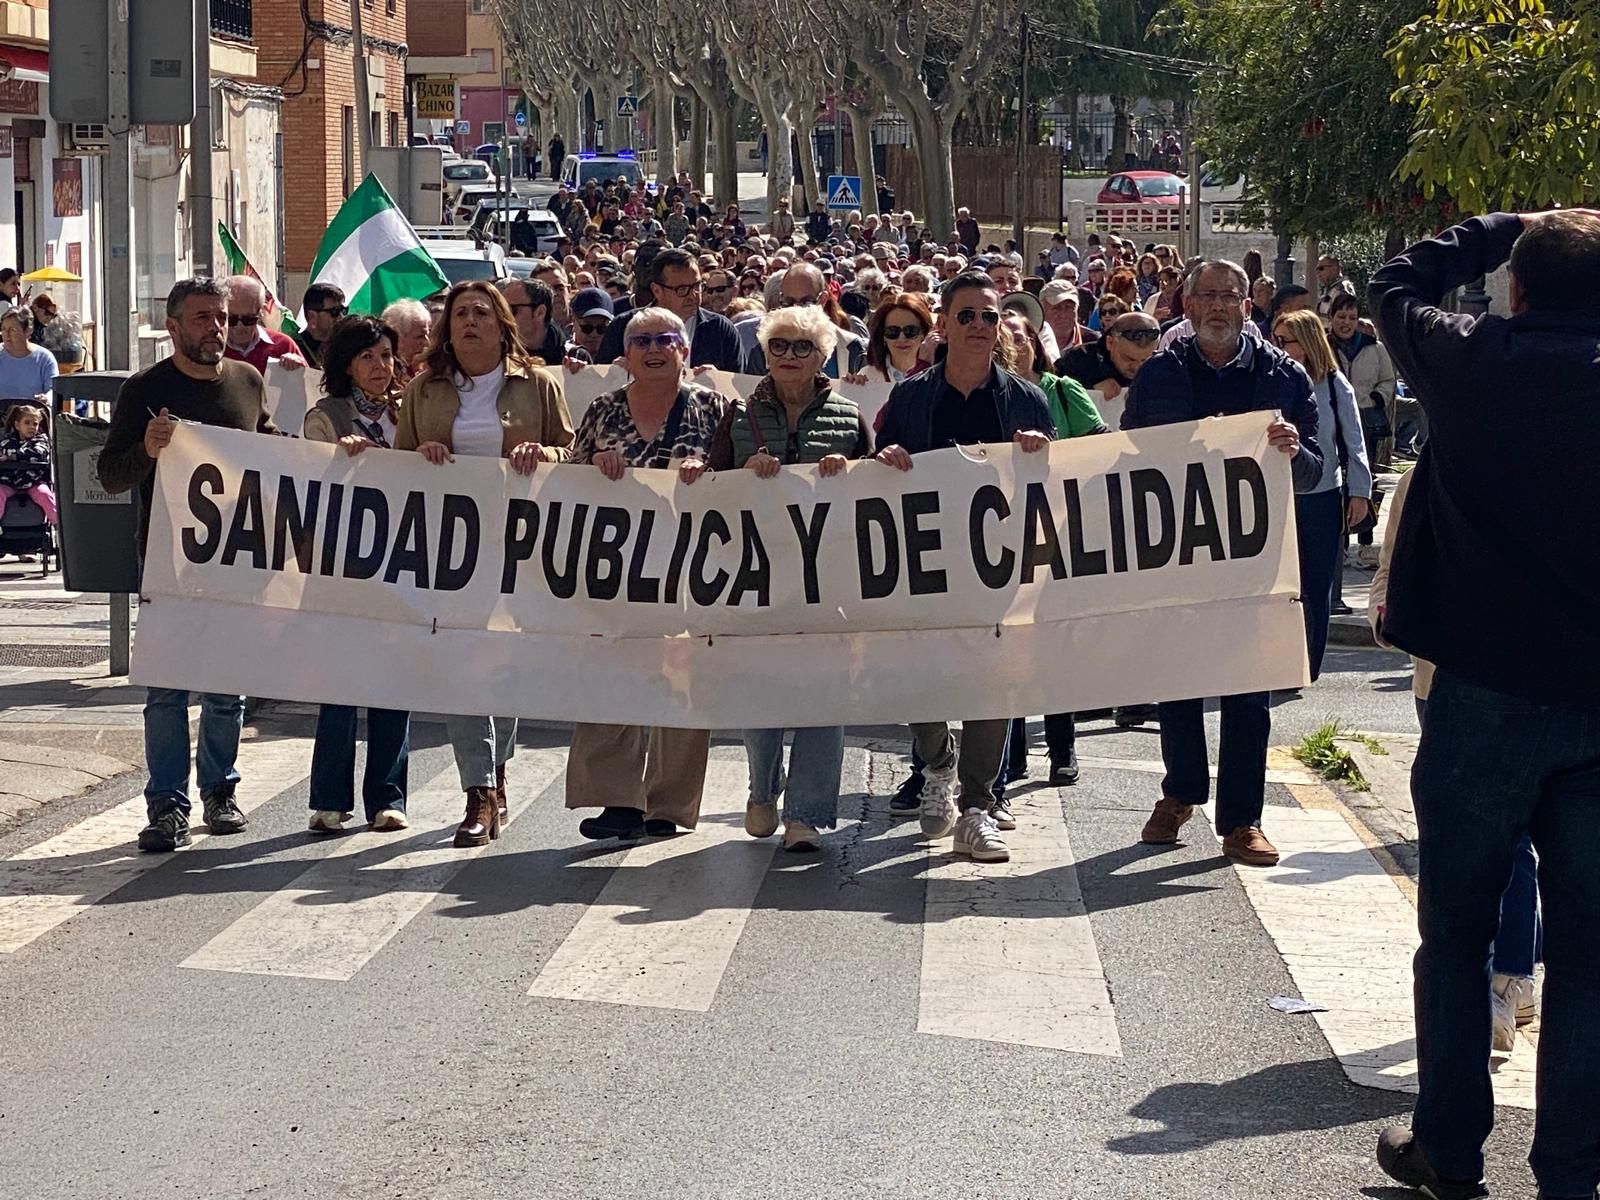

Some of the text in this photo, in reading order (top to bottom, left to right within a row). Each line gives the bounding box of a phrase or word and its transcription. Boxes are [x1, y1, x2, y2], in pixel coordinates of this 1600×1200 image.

[417, 82, 455, 99] BAZAR
[417, 100, 455, 112] CHINO
[182, 457, 1268, 606] SANIDAD PUBLICA Y DE CALIDAD
